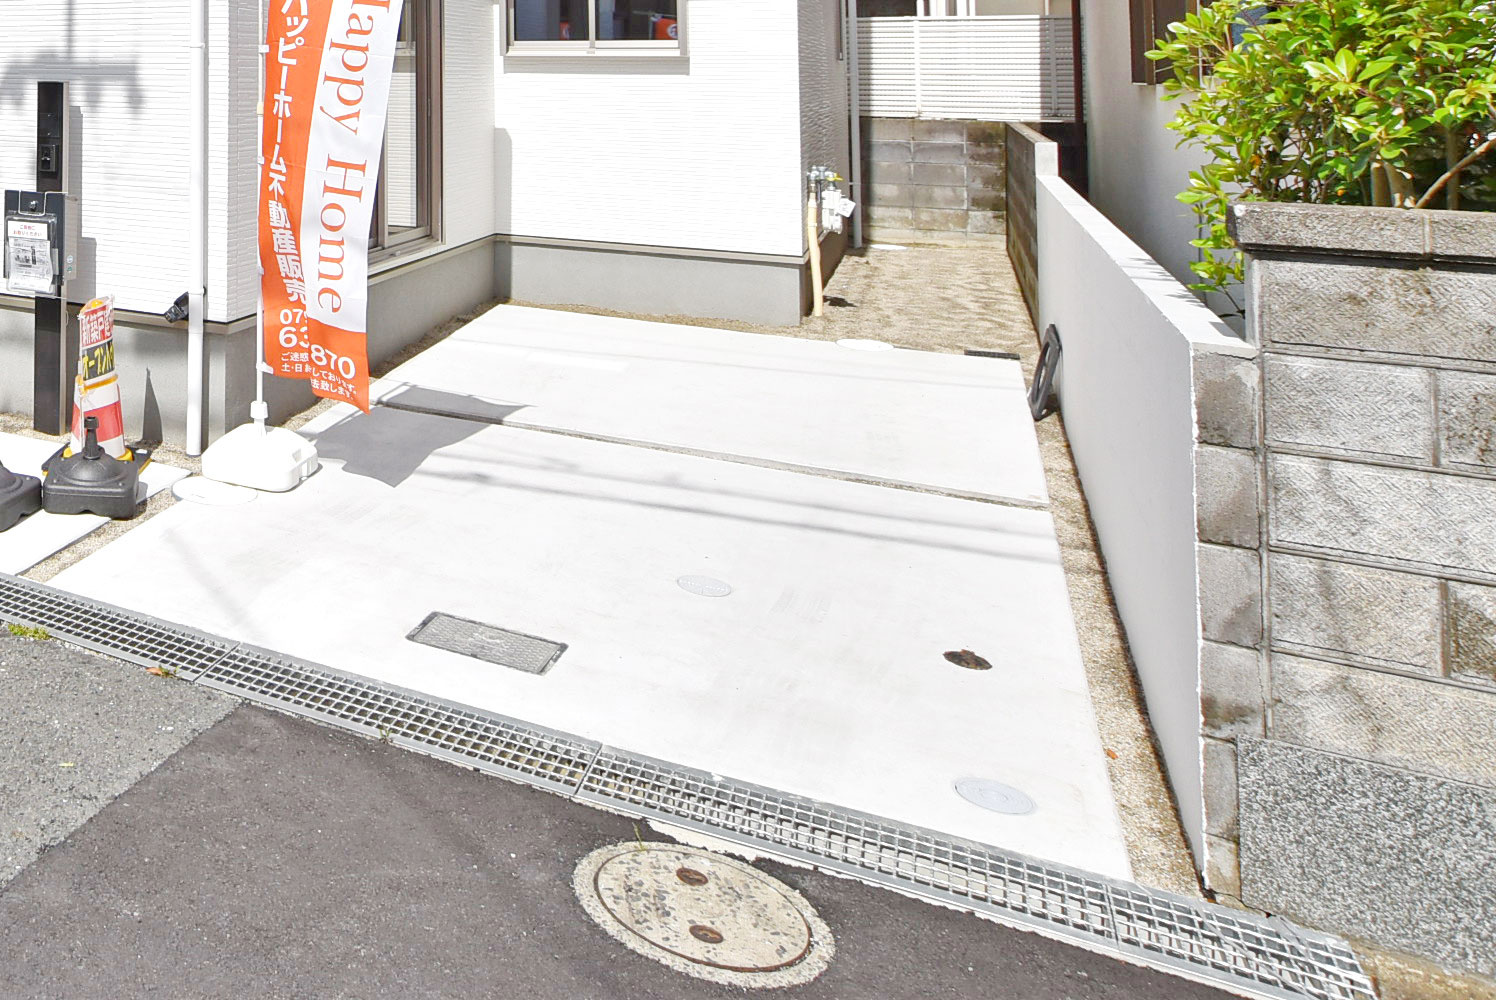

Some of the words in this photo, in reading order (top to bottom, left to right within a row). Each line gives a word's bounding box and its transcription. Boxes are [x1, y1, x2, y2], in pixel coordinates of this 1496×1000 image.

[317, 153, 368, 316] Home
[279, 308, 309, 325] 07
[310, 344, 356, 380] 870
